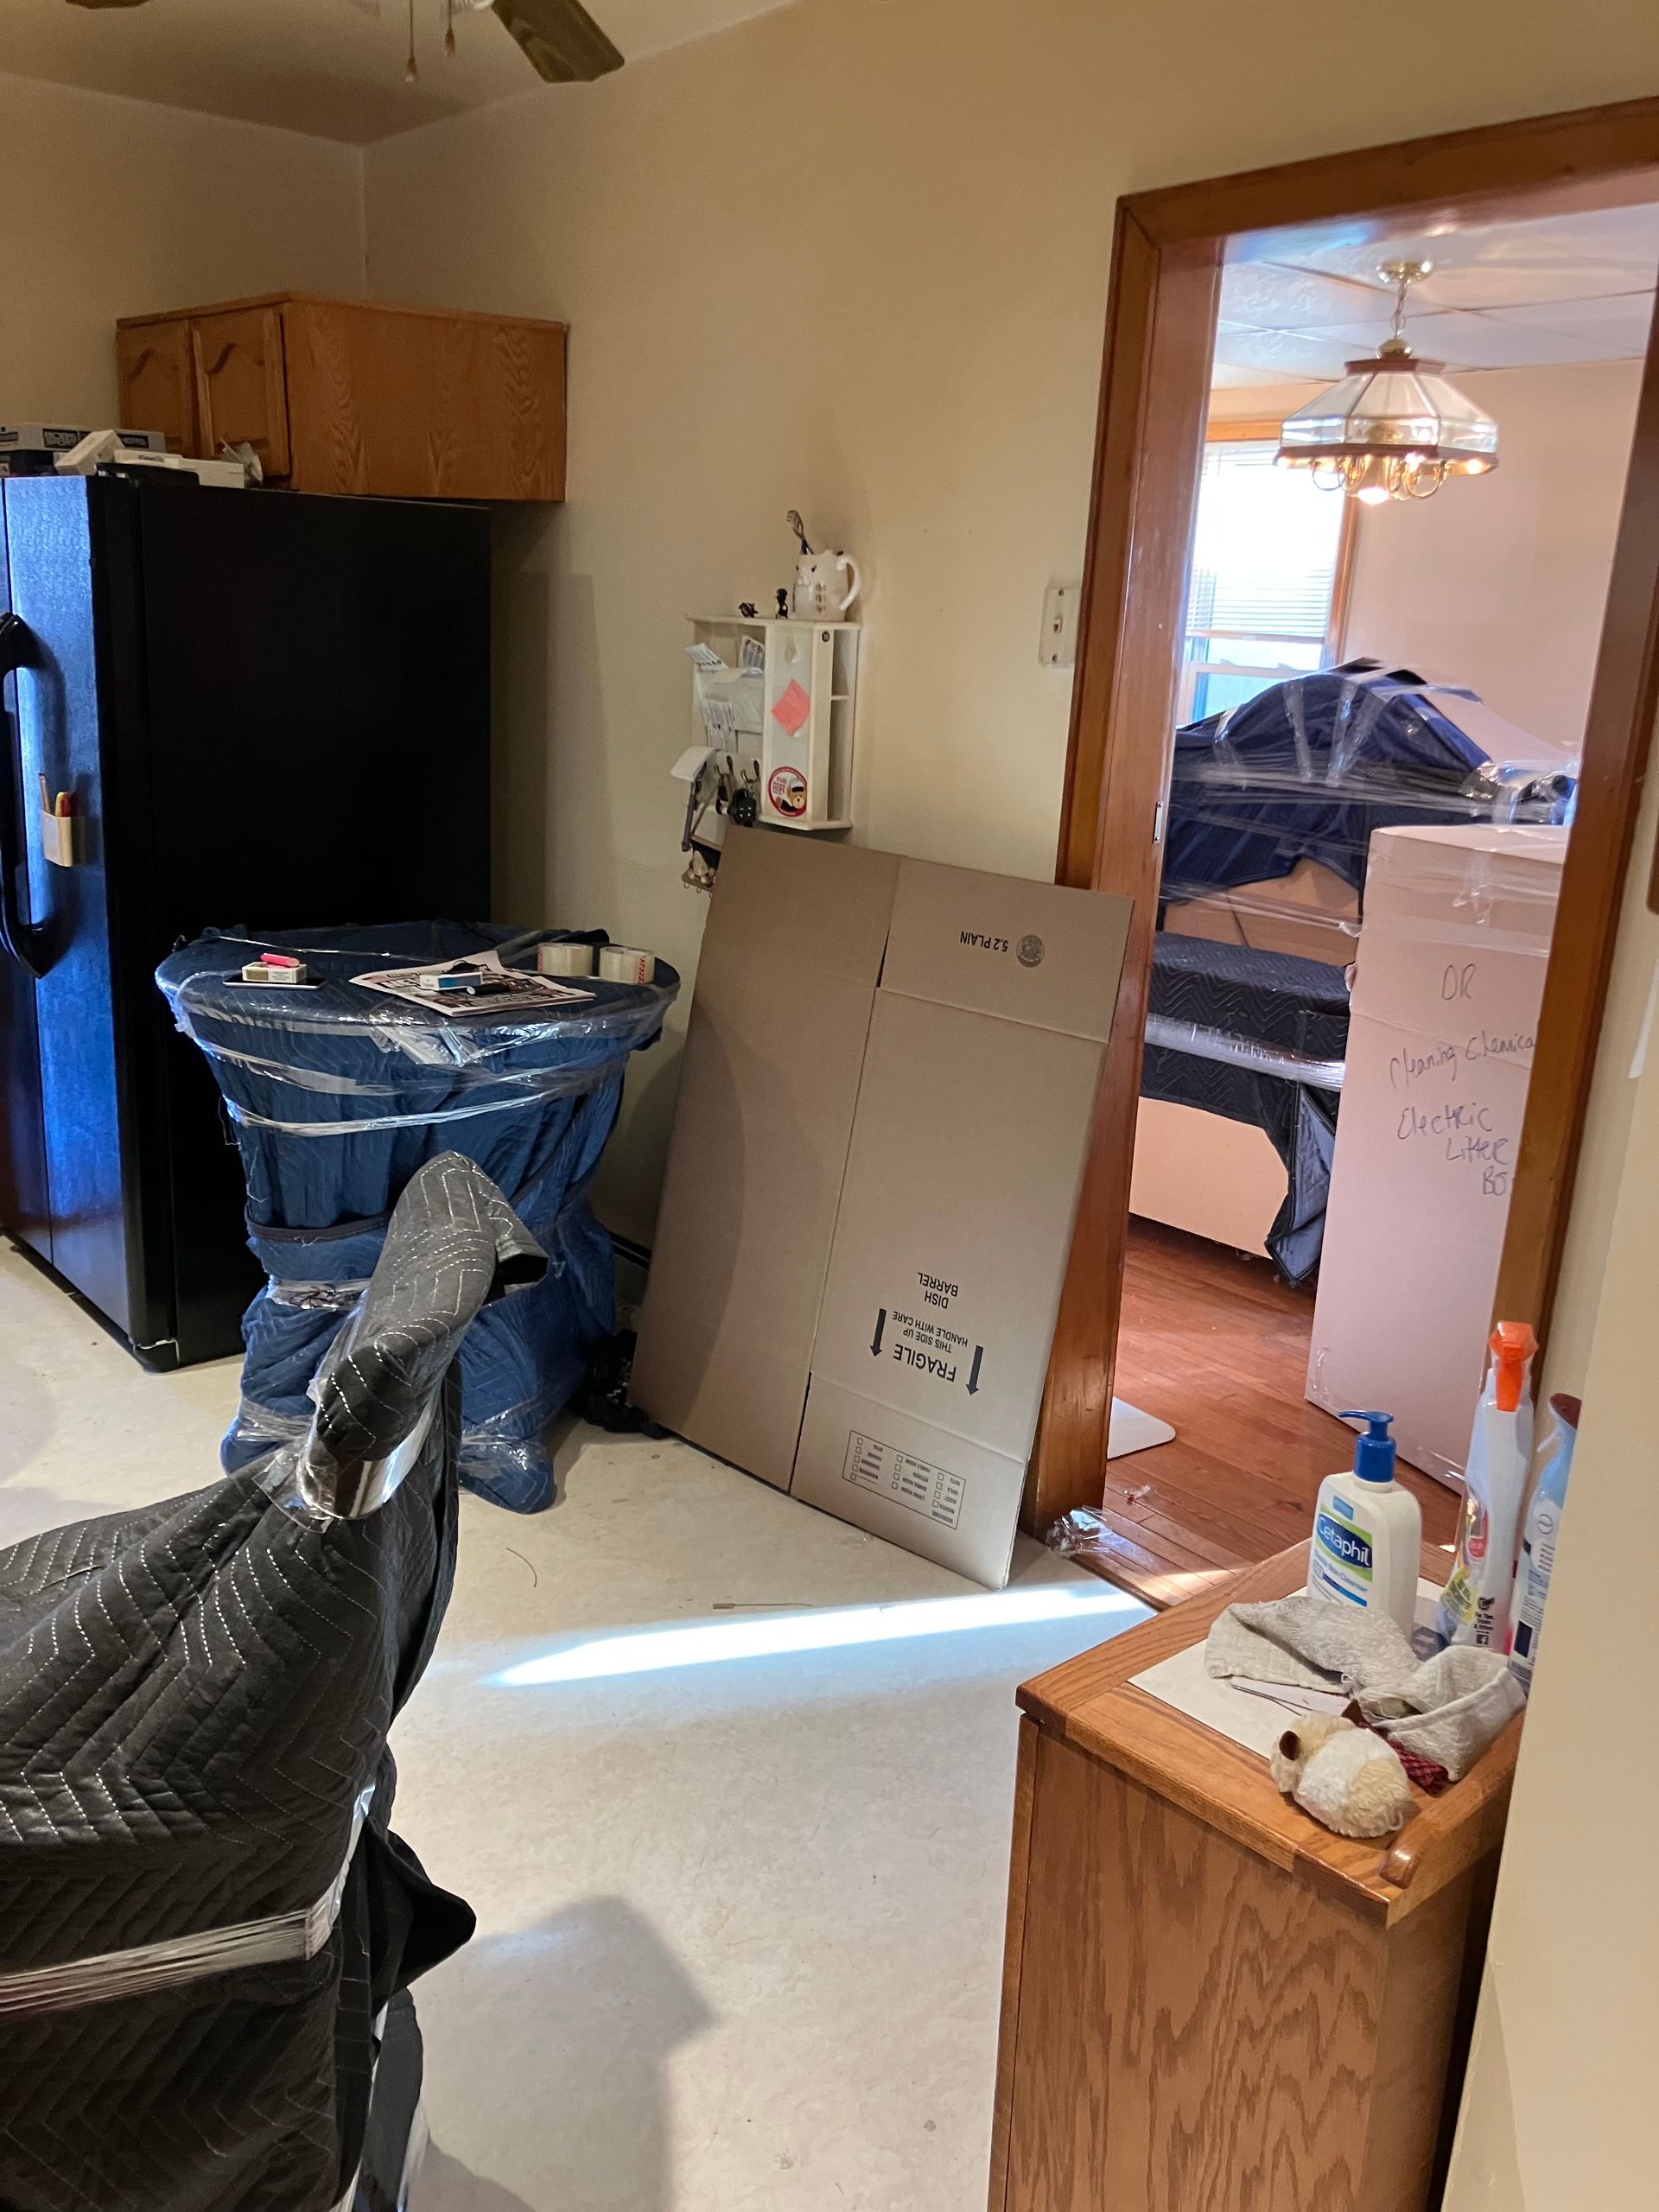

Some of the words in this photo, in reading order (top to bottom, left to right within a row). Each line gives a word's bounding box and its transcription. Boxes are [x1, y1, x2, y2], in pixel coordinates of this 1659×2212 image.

[960, 931, 991, 949] PLAIN
[994, 938, 1008, 952] 5.2
[1441, 963, 1476, 1001] OR
[1465, 1030, 1535, 1061] Chemica
[1482, 1165, 1508, 1197] BO
[918, 1272, 958, 1296] BARREL
[925, 1290, 949, 1309] DISH
[893, 1311, 913, 1325] CARE
[915, 1319, 934, 1333] WITH
[903, 1328, 914, 1339] UP
[916, 1333, 933, 1347] SIDE
[937, 1327, 968, 1346] HANDLE
[934, 1340, 951, 1352] THIS
[893, 1344, 957, 1382] FRAGILE
[1318, 1517, 1370, 1567] Cetaphil
